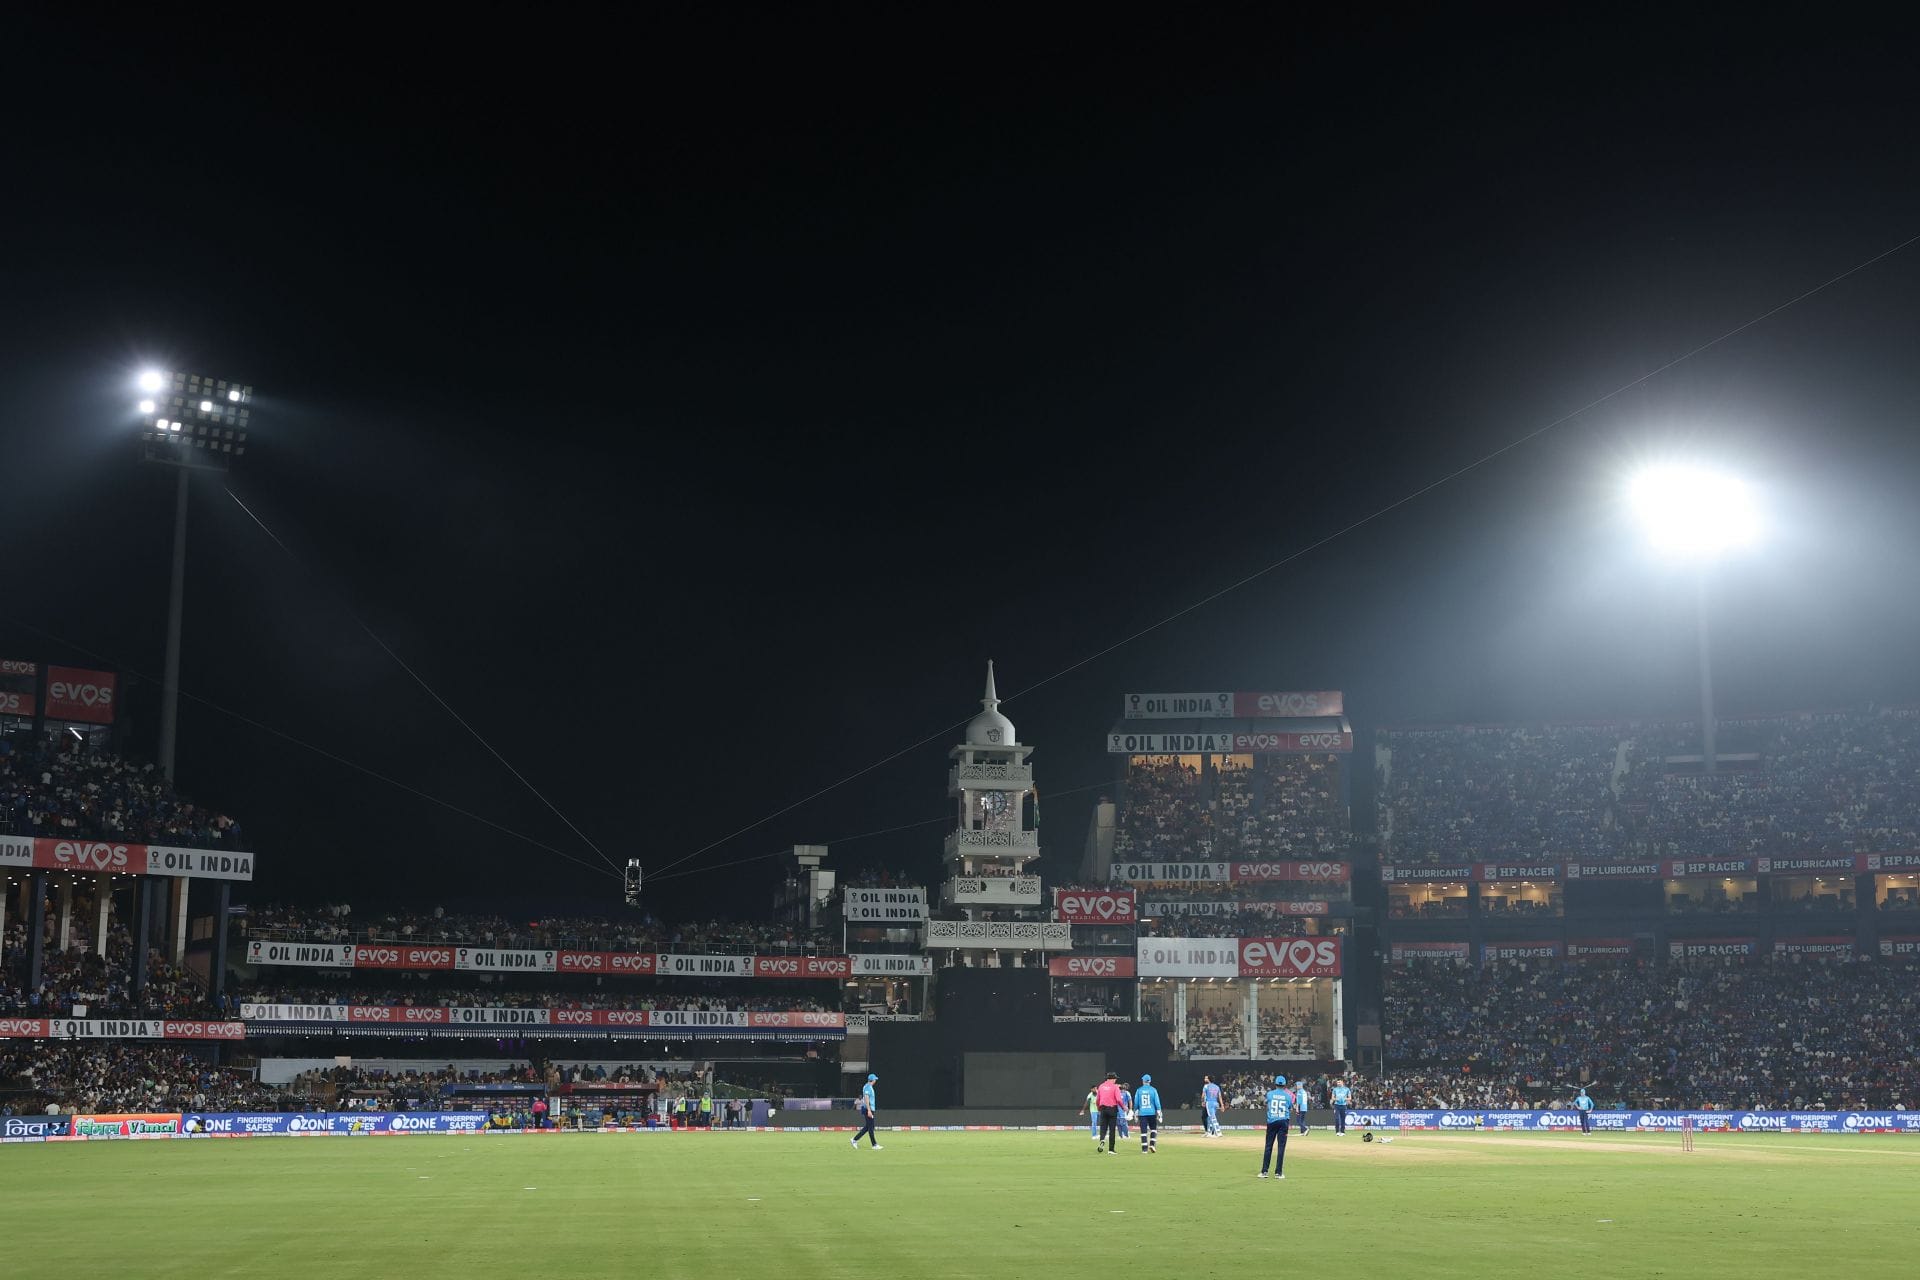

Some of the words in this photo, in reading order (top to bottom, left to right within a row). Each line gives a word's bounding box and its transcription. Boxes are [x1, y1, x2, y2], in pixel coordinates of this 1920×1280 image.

[3, 660, 35, 673] evos
[50, 682, 112, 706] evos
[1146, 699, 1168, 713] OIL
[1173, 699, 1212, 713] INDIA
[1258, 694, 1318, 714] evos
[1125, 735, 1154, 751] OIL
[1162, 735, 1216, 751] INDIA
[1237, 735, 1278, 748] evos
[1300, 734, 1341, 748] evos
[0, 844, 31, 858] DIA
[54, 842, 128, 870] evos
[165, 852, 192, 870] OIL
[201, 855, 250, 874] INDIA
[1689, 863, 1706, 872] HP
[1709, 862, 1744, 872] RACER
[1774, 860, 1789, 869] HP
[1790, 859, 1851, 868] LUBRICANTS
[1884, 856, 1903, 866] HP
[1127, 865, 1154, 880] OIL
[1162, 865, 1211, 880] INDIA
[1238, 864, 1281, 878] evos
[1300, 863, 1341, 878] evos
[1397, 869, 1411, 878] HP
[1413, 868, 1469, 878] LUBRICANTS
[1500, 867, 1517, 877] HP
[1519, 867, 1555, 876] RACER
[1582, 866, 1597, 875] HP
[1599, 865, 1656, 875] LUBRICANTS
[861, 893, 880, 903] OIL
[885, 893, 919, 904] INDIA
[862, 908, 880, 918] OIL
[886, 908, 920, 918] INDIA
[1062, 896, 1130, 919] evos
[1160, 903, 1181, 914] OIL
[1186, 903, 1225, 914] INDIA
[1290, 902, 1322, 913] evos
[269, 946, 290, 961] OIL
[296, 947, 334, 962] INDIA
[1500, 949, 1517, 958] HP
[1687, 945, 1705, 955] HP
[1709, 945, 1749, 955] RACER
[1896, 943, 1914, 953] HP
[357, 949, 398, 964] evos
[409, 950, 450, 966] evos
[475, 952, 495, 966] OIL
[500, 953, 537, 967] INDIA
[562, 954, 601, 970] evos
[612, 955, 651, 970] evos
[1154, 950, 1181, 964] OIL
[1188, 950, 1235, 964] INDIA
[1243, 940, 1336, 973] evos
[676, 958, 695, 972] OIL
[700, 959, 735, 973] INDIA
[760, 959, 798, 974] evos
[808, 960, 846, 975] evos
[864, 958, 881, 970] OIL
[886, 959, 915, 971] INDIA
[1068, 958, 1115, 975] evos
[256, 1005, 281, 1019] OIL
[288, 1006, 333, 1020] INDIA
[354, 1007, 390, 1021] evos
[406, 1008, 442, 1022] evos
[463, 1009, 487, 1022] OIL
[493, 1009, 536, 1023] INDIA
[557, 1010, 593, 1024] evos
[607, 1011, 643, 1024] evos
[664, 1012, 687, 1025] OIL
[693, 1012, 734, 1025] INDIA
[755, 1012, 789, 1025] evos
[803, 1012, 838, 1025] evos
[0, 1020, 40, 1035] evos
[66, 1021, 93, 1035] OIL
[101, 1021, 148, 1036] INDIA
[166, 1022, 202, 1036] evos
[207, 1023, 242, 1037] evos
[1270, 1100, 1286, 1114] 95
[237, 1116, 283, 1124] FINGERPRINT
[441, 1115, 485, 1123] FINGERPRINT
[449, 1122, 476, 1130] SAFES
[1801, 1120, 1829, 1128] SAFES
[127, 1119, 176, 1135] Vimal
[245, 1123, 273, 1132] SAFES
[348, 1122, 375, 1131] SFES
